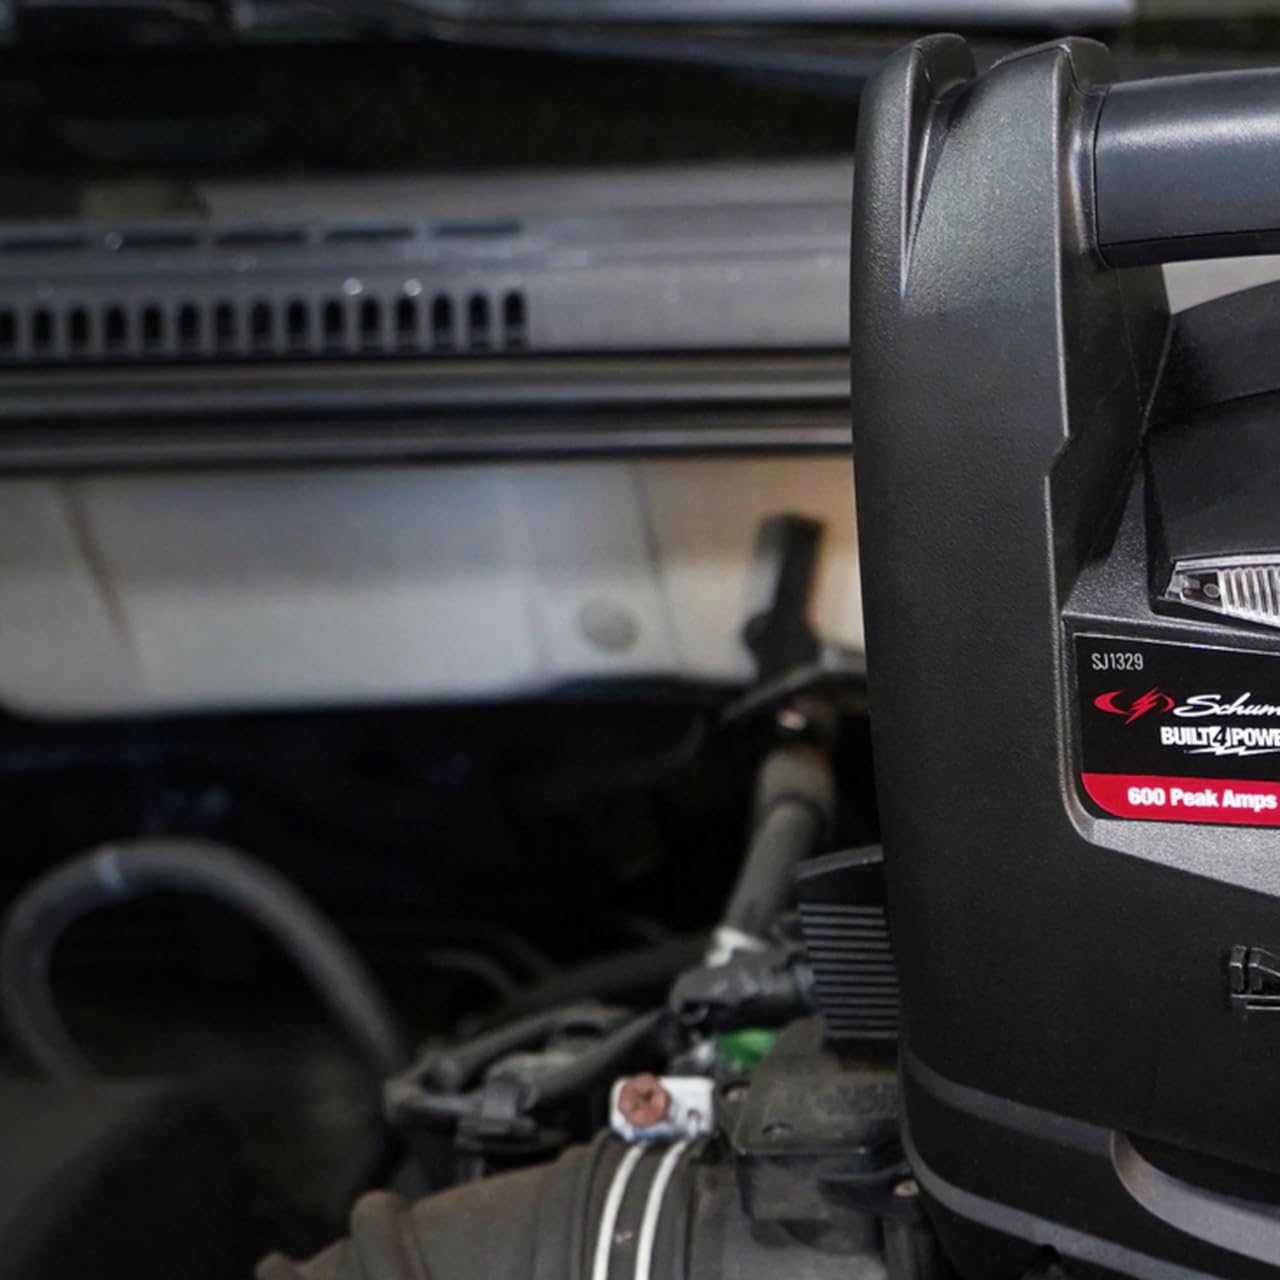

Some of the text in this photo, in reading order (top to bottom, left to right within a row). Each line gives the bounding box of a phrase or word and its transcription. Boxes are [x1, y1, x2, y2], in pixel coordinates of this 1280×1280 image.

[1091, 652, 1145, 671] SJ1329
[1127, 787, 1279, 813] 600 Peak Amps
